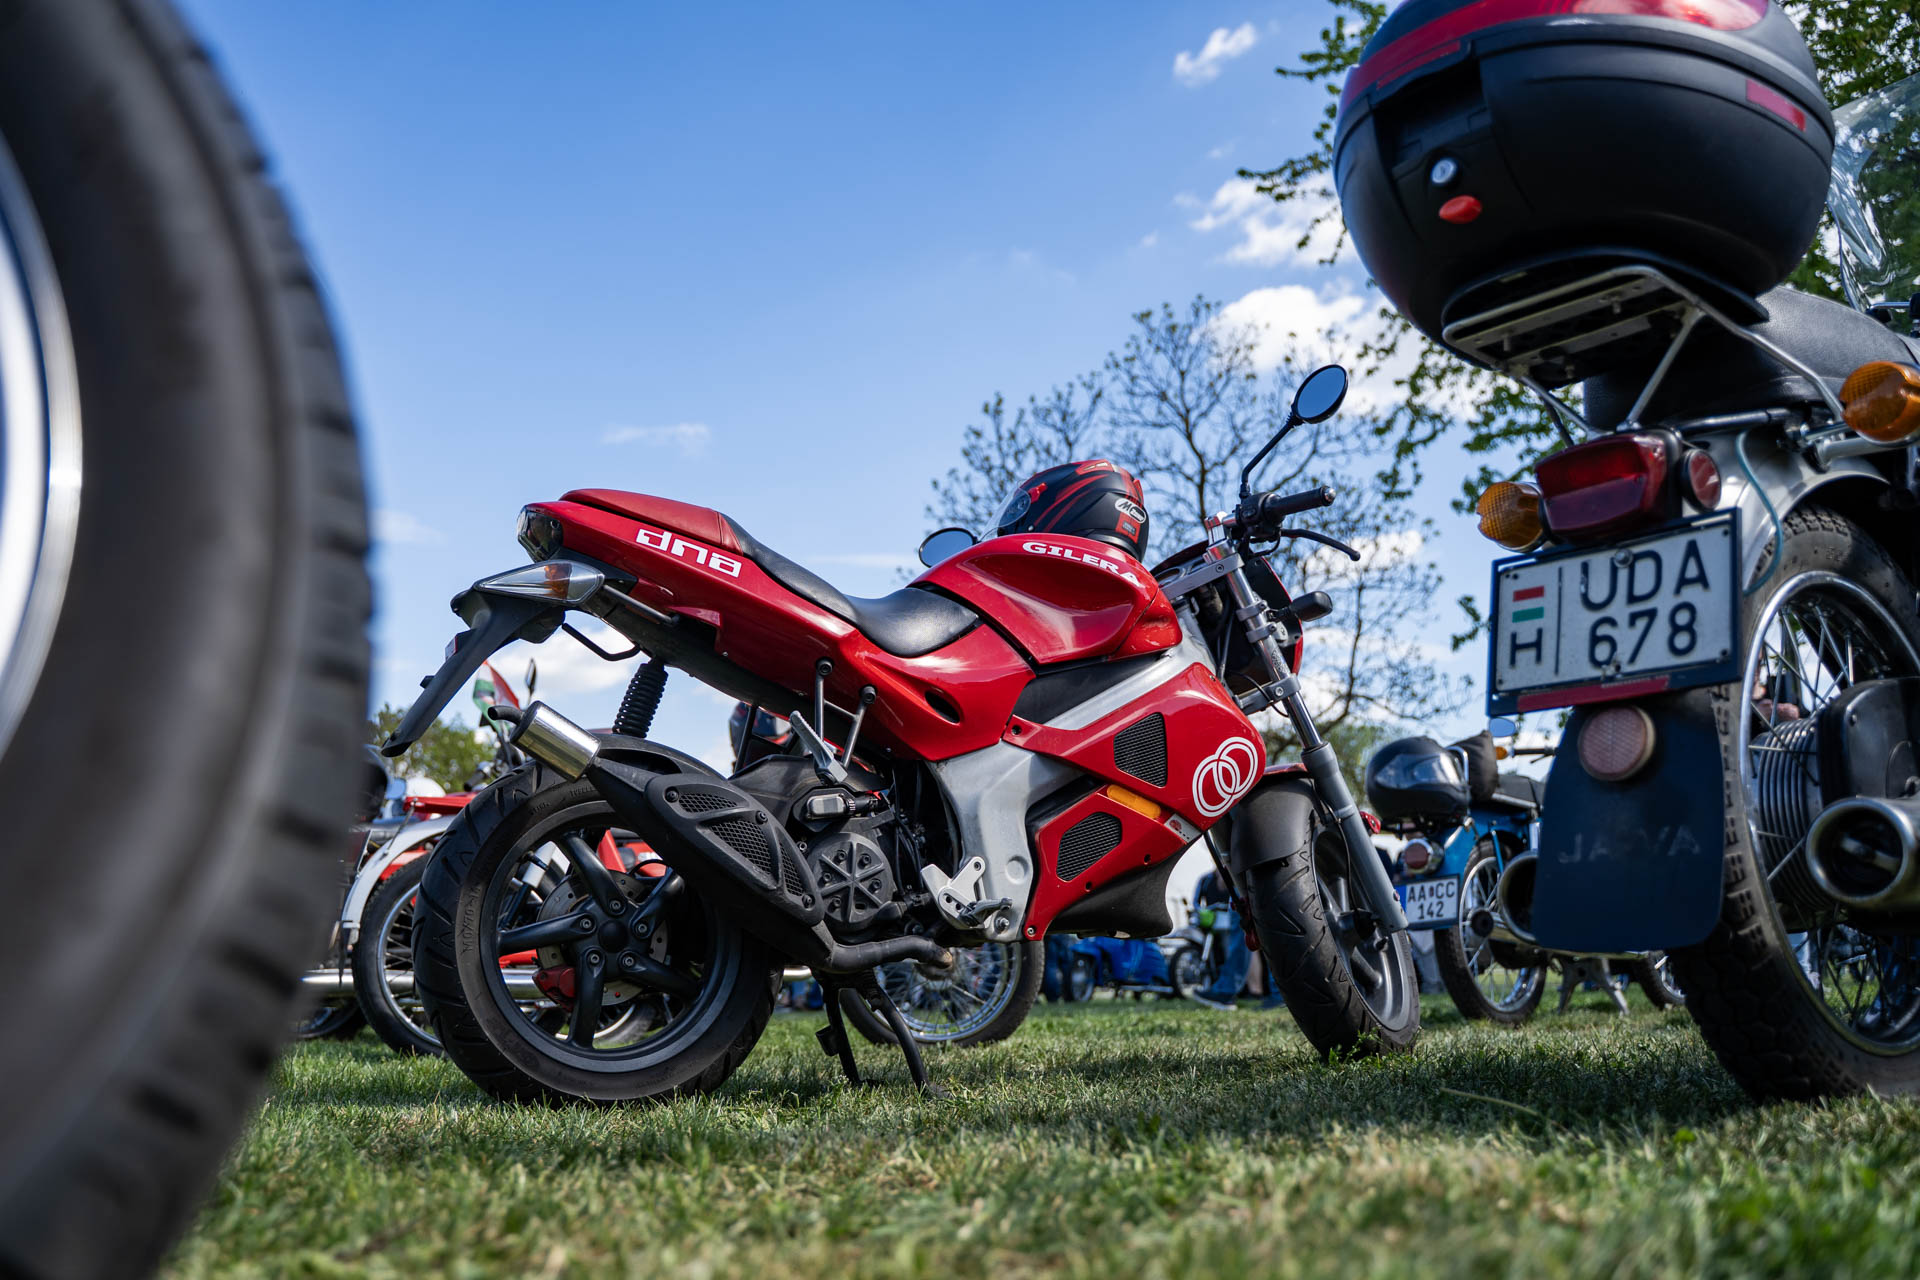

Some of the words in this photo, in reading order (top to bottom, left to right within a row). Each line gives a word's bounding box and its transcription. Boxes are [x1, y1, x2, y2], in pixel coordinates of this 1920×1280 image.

[636, 528, 742, 578] dna
[1022, 541, 1144, 588] GILERA
[1580, 539, 1710, 611] UDA
[1509, 627, 1543, 668] H
[1588, 601, 1698, 670] 678
[1408, 884, 1426, 903] AA
[1435, 881, 1455, 899] CC
[1417, 901, 1445, 920] 142
